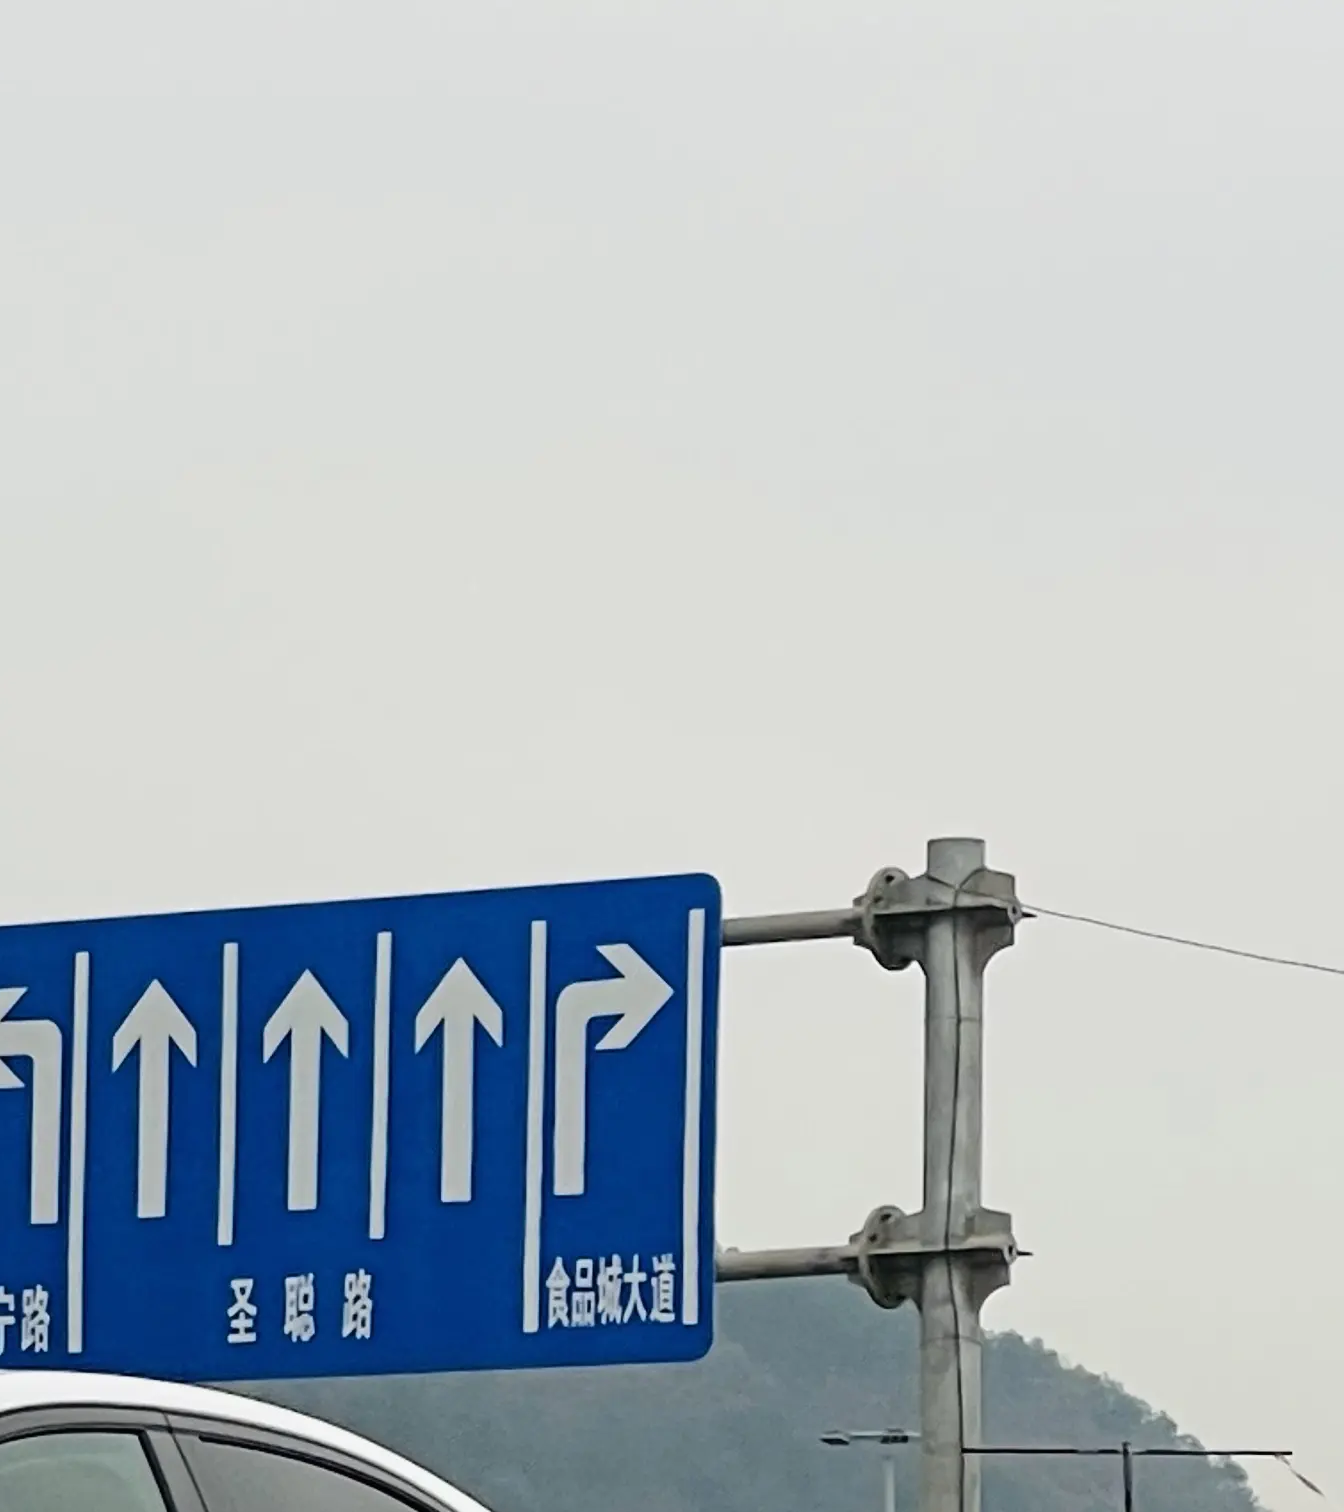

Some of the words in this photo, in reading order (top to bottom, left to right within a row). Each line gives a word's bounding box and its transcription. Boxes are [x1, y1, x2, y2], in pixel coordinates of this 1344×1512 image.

[226, 1268, 374, 1344] 圣聪路
[545, 1252, 677, 1329] 食品城大道
